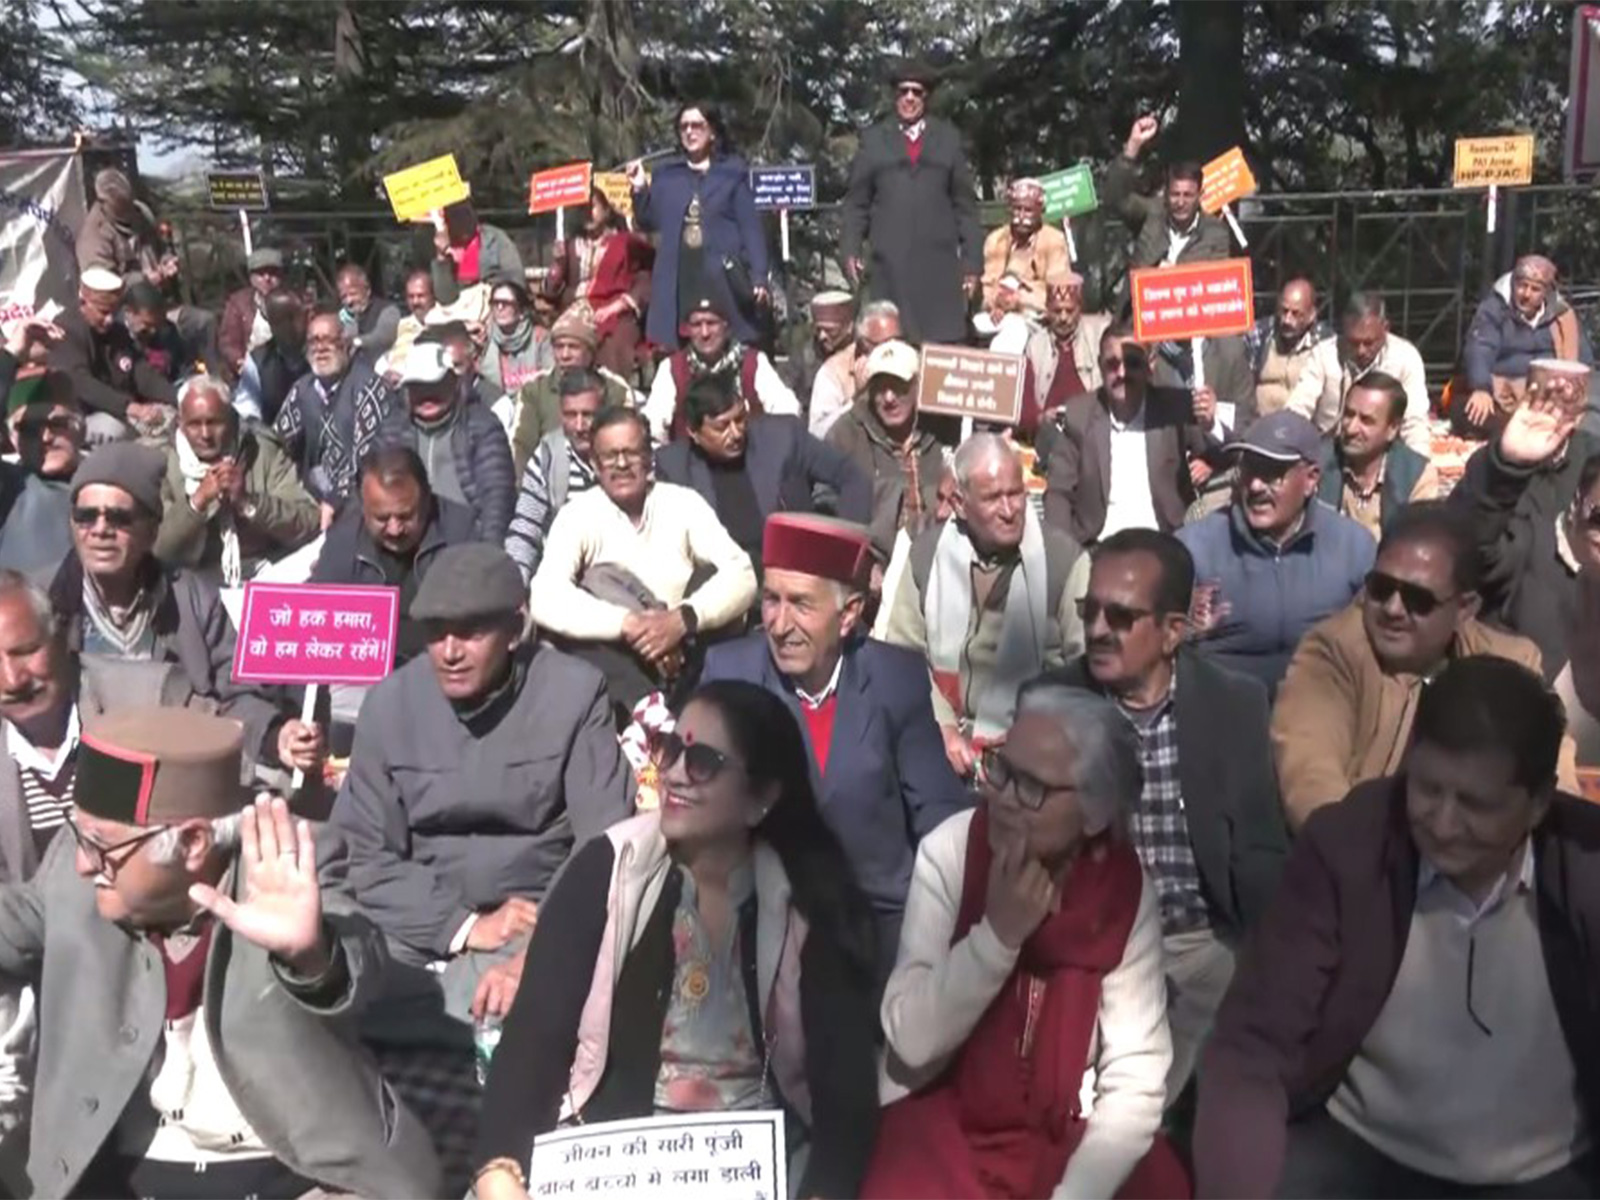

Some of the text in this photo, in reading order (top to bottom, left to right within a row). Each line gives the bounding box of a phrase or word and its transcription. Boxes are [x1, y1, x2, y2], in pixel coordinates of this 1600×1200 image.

[269, 603, 377, 633] जो हक हमारा,
[249, 633, 268, 658] वो
[274, 640, 299, 659] हम
[305, 636, 345, 660] लेकर
[561, 1128, 743, 1164] जीवन की सारी पूंजी
[537, 1179, 576, 1196] बाल
[672, 1168, 709, 1185] लगा
[718, 1158, 762, 1183] डाली
